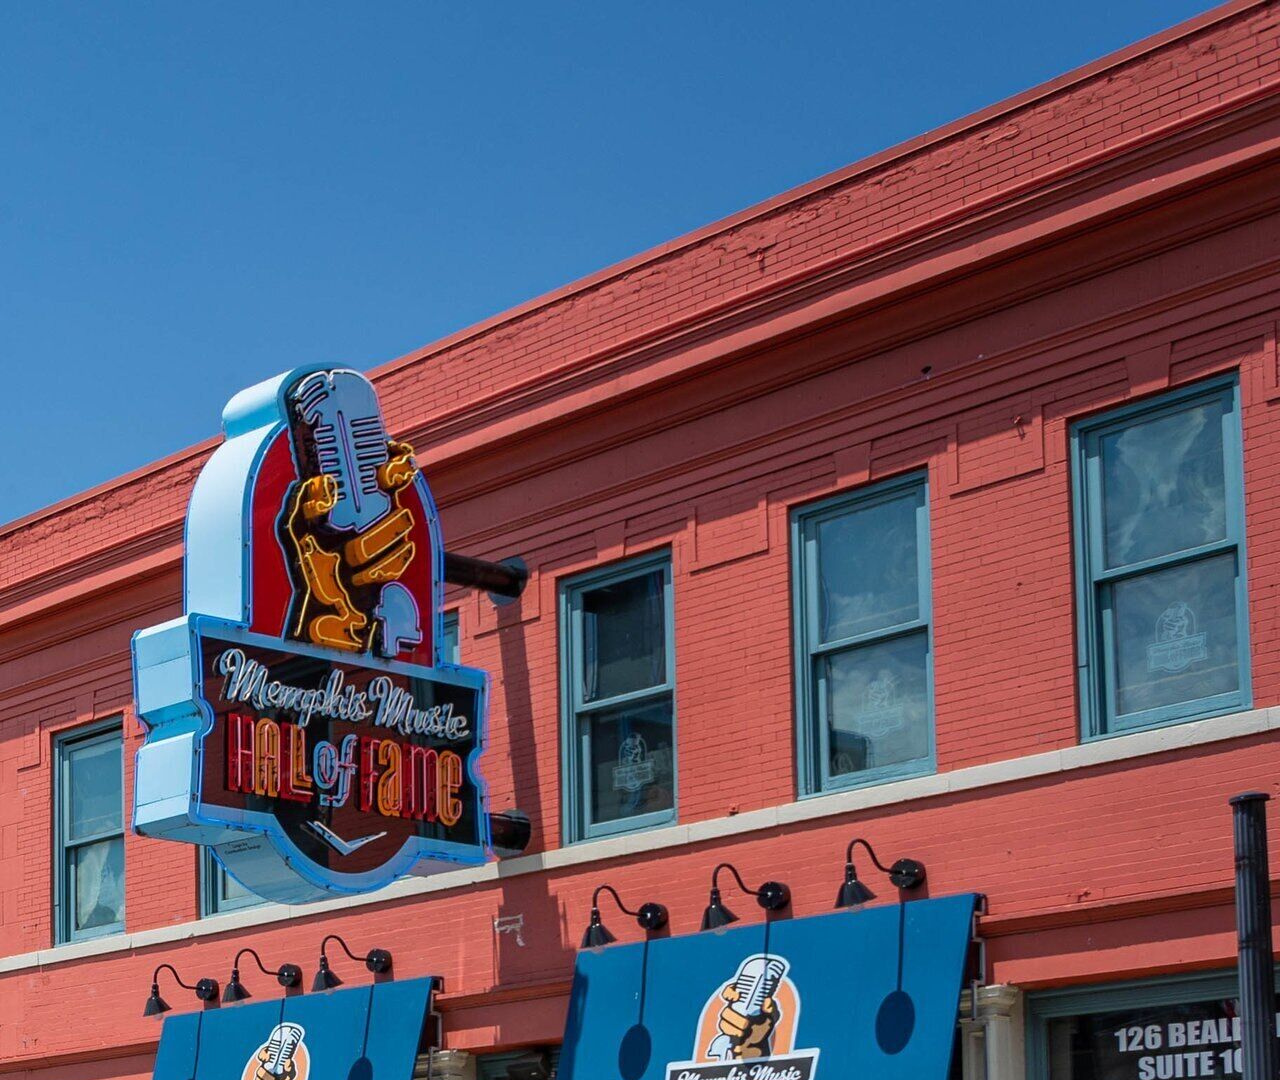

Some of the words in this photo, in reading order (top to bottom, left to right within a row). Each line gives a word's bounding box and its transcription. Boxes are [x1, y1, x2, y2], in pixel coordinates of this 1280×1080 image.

[219, 649, 374, 728] Memphis
[368, 676, 471, 740] Music
[227, 713, 315, 804] HALL
[313, 733, 358, 807] of
[1114, 1024, 1162, 1052] 126
